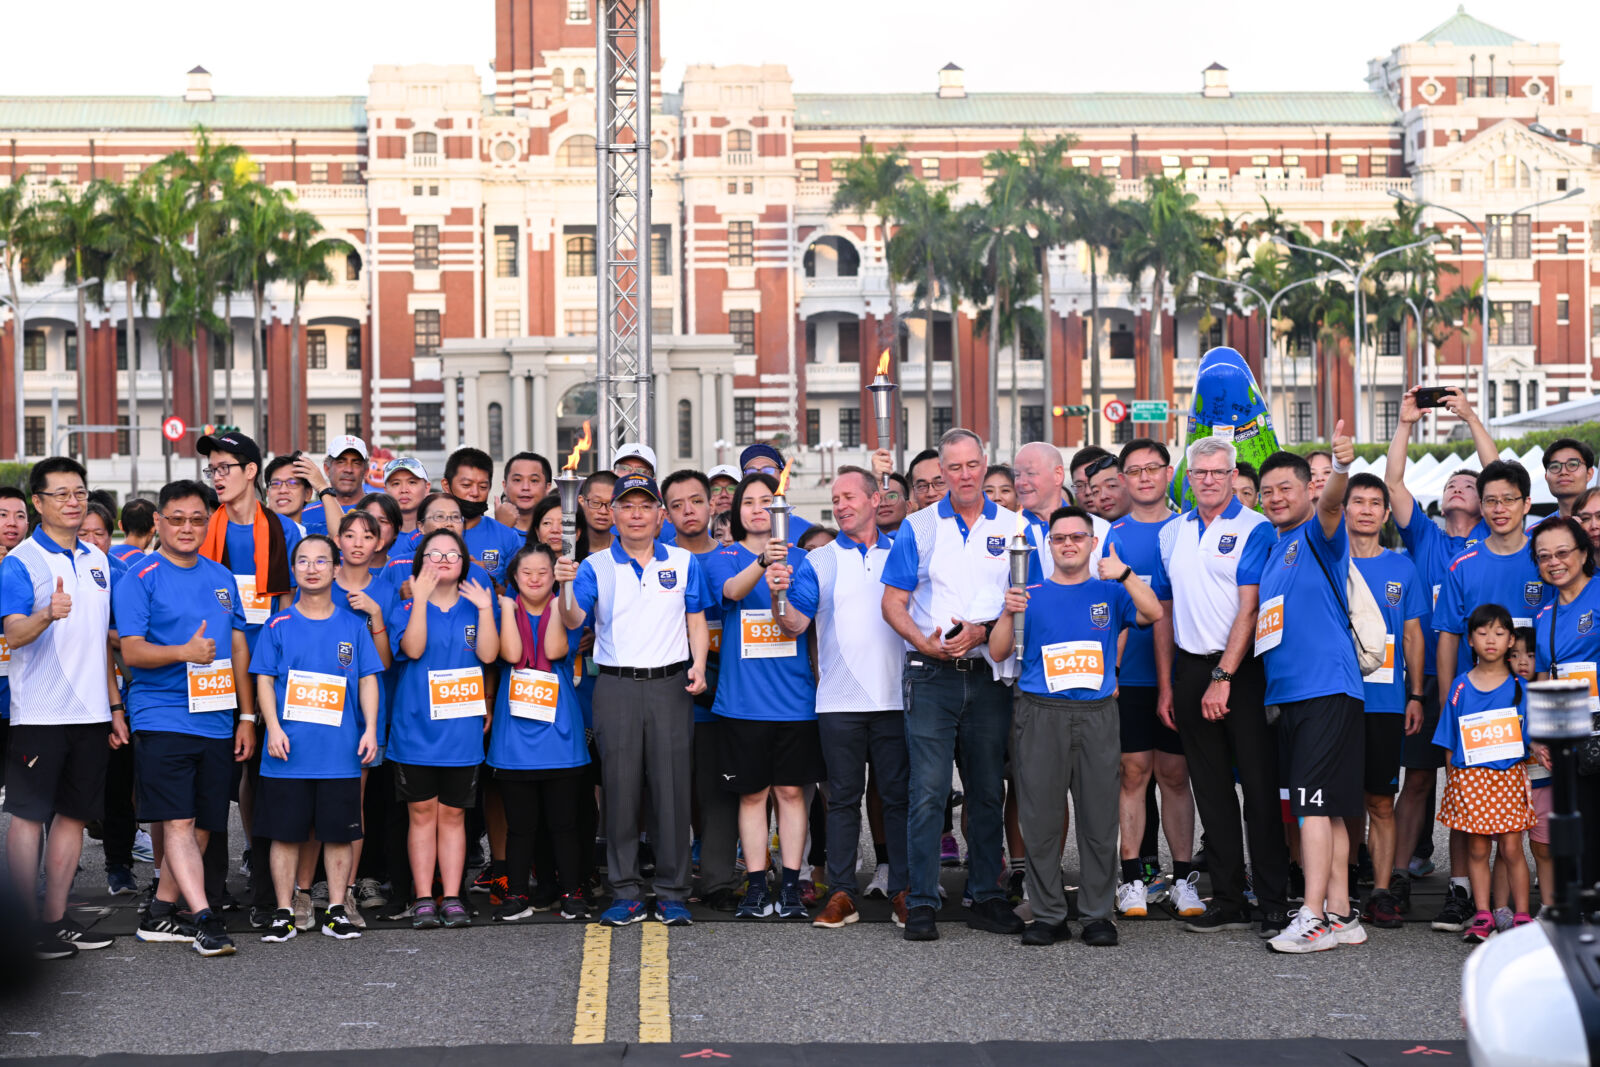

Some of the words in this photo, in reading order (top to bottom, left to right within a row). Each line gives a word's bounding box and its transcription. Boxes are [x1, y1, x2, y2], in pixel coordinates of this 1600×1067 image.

[988, 537, 1000, 545] 25
[660, 571, 671, 579] 25
[1093, 607, 1104, 615] 25
[751, 623, 785, 637] 939
[1054, 655, 1098, 670] 9478
[197, 674, 232, 690] 9426
[439, 682, 479, 698] 9450
[296, 686, 339, 704] 9483
[514, 682, 553, 701] 9462
[1471, 723, 1514, 742] 9491
[1297, 787, 1324, 807] 14
